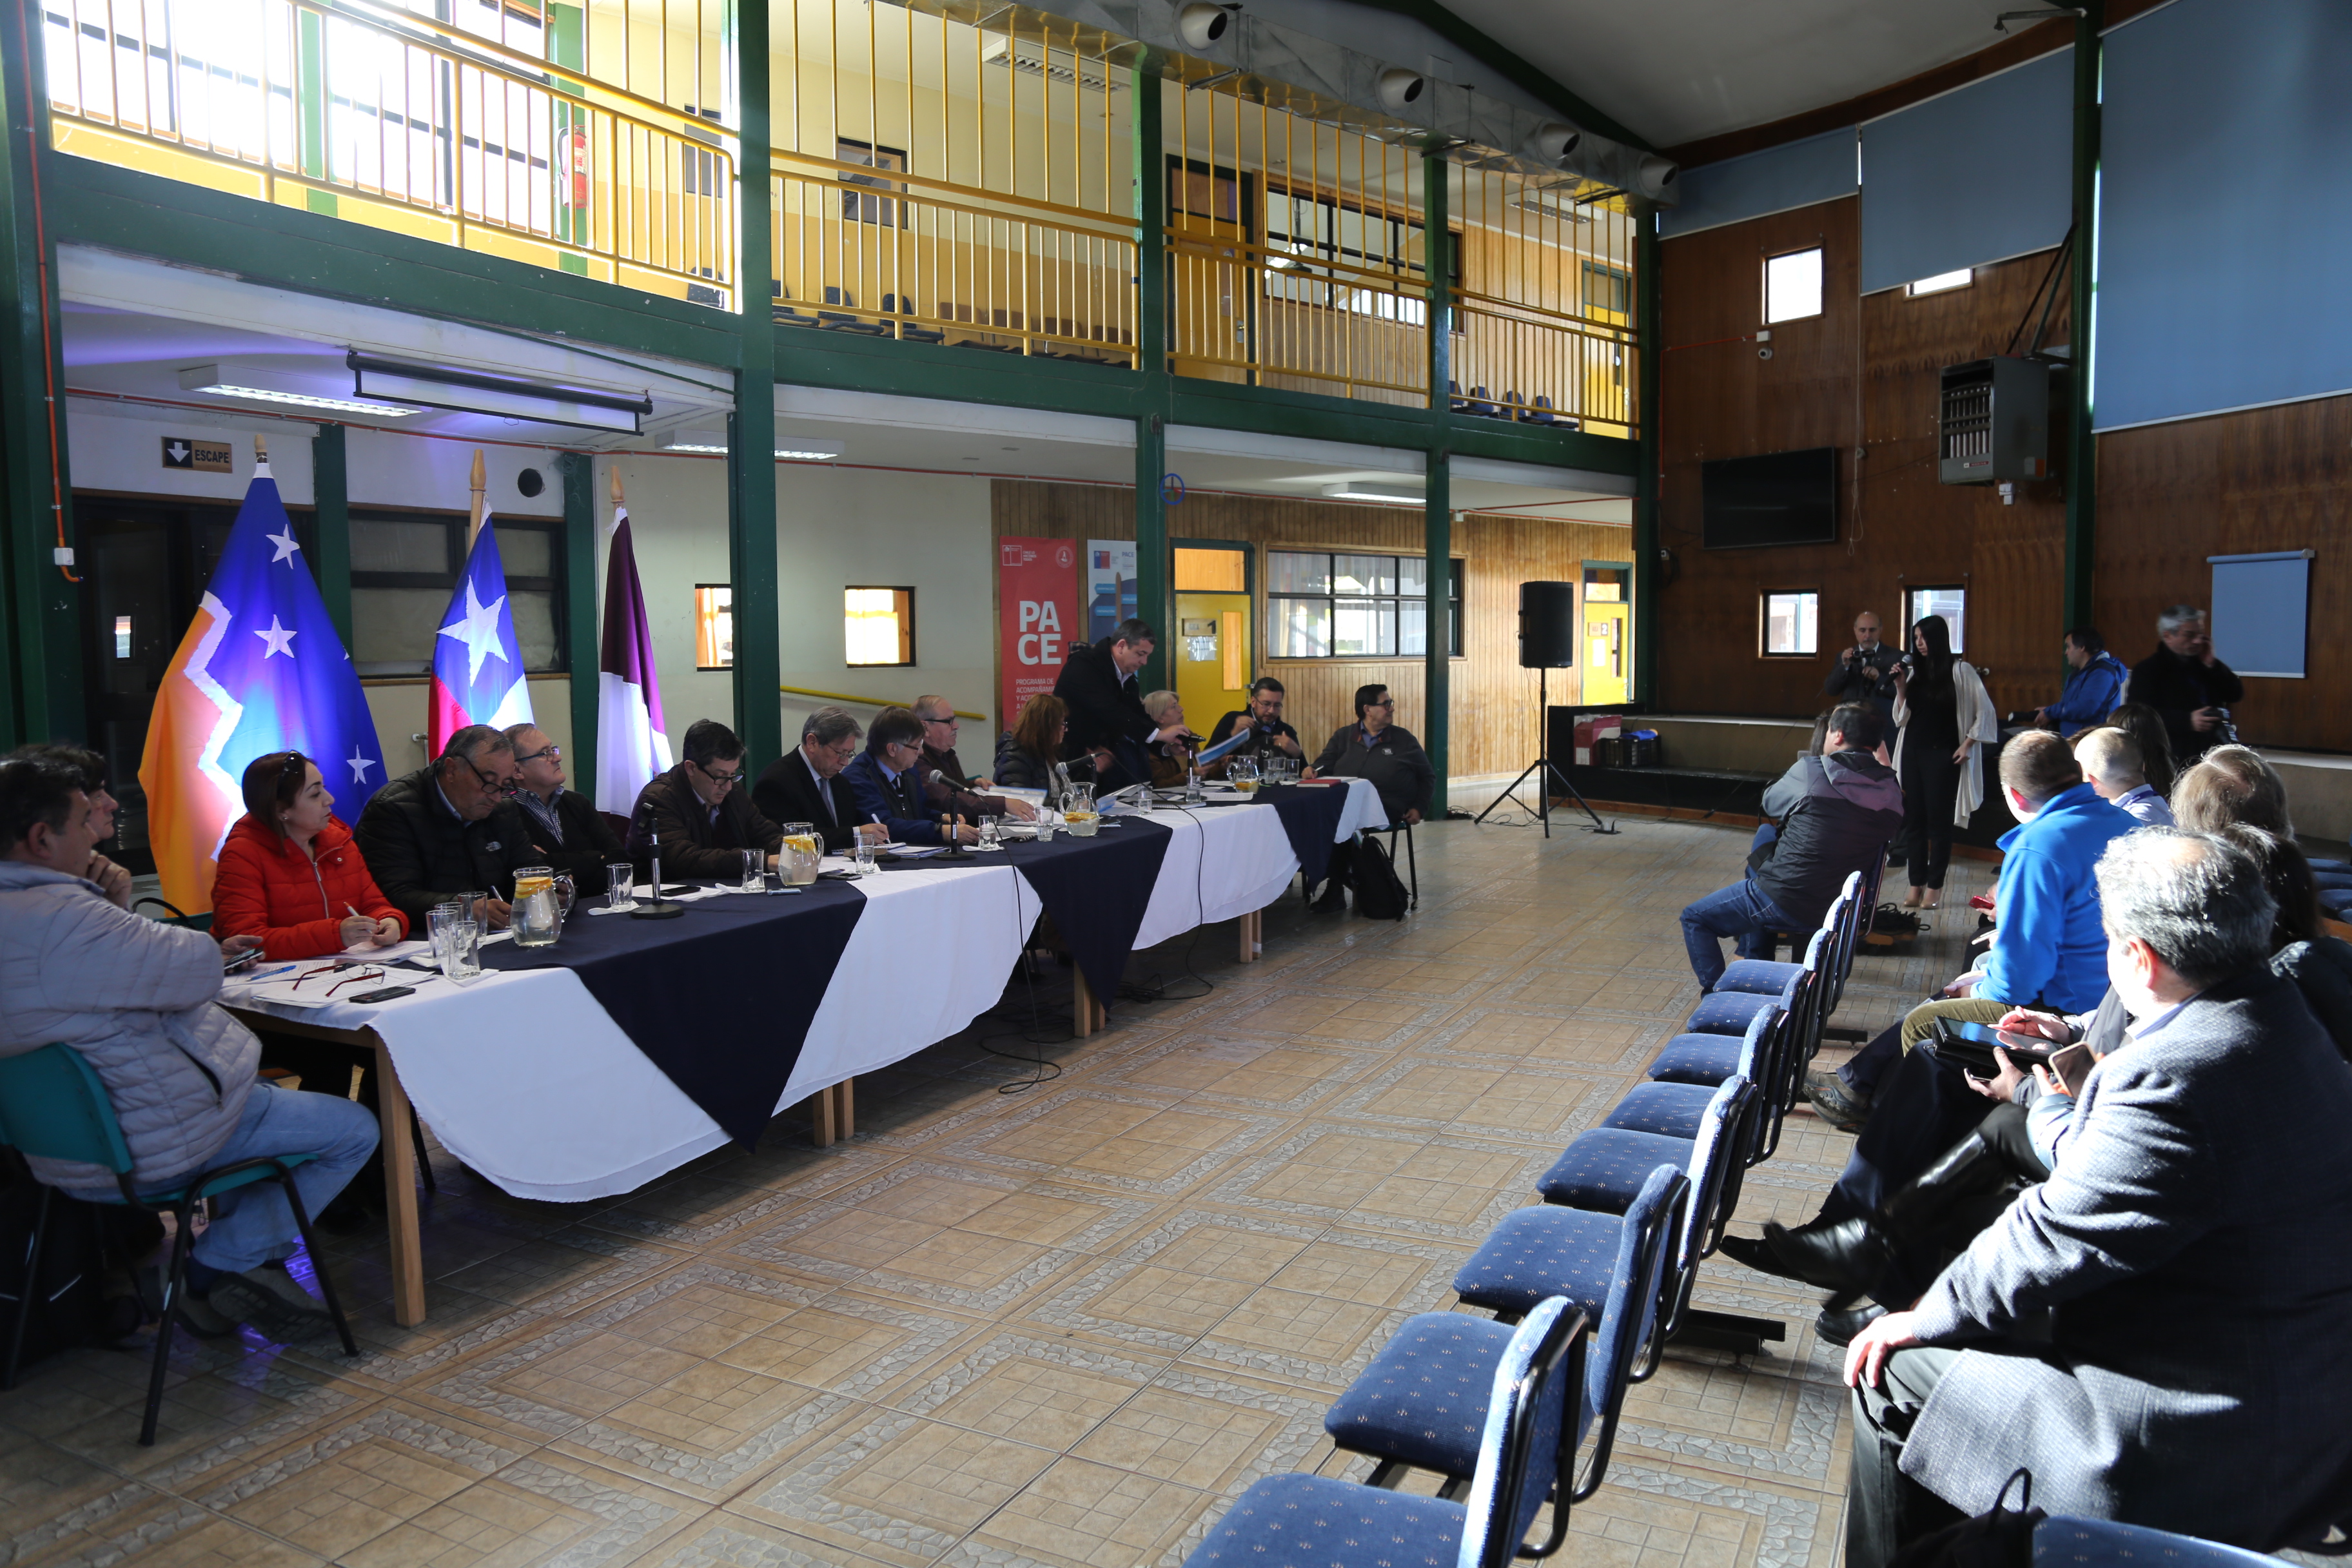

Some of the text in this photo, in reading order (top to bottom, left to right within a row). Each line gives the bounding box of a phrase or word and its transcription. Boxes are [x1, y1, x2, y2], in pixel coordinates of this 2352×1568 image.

[195, 449, 229, 463] ESCAPE
[1019, 600, 1061, 632] PA
[1208, 620, 1216, 634] 1
[1601, 623, 1608, 635] 2
[1017, 634, 1062, 665] CE
